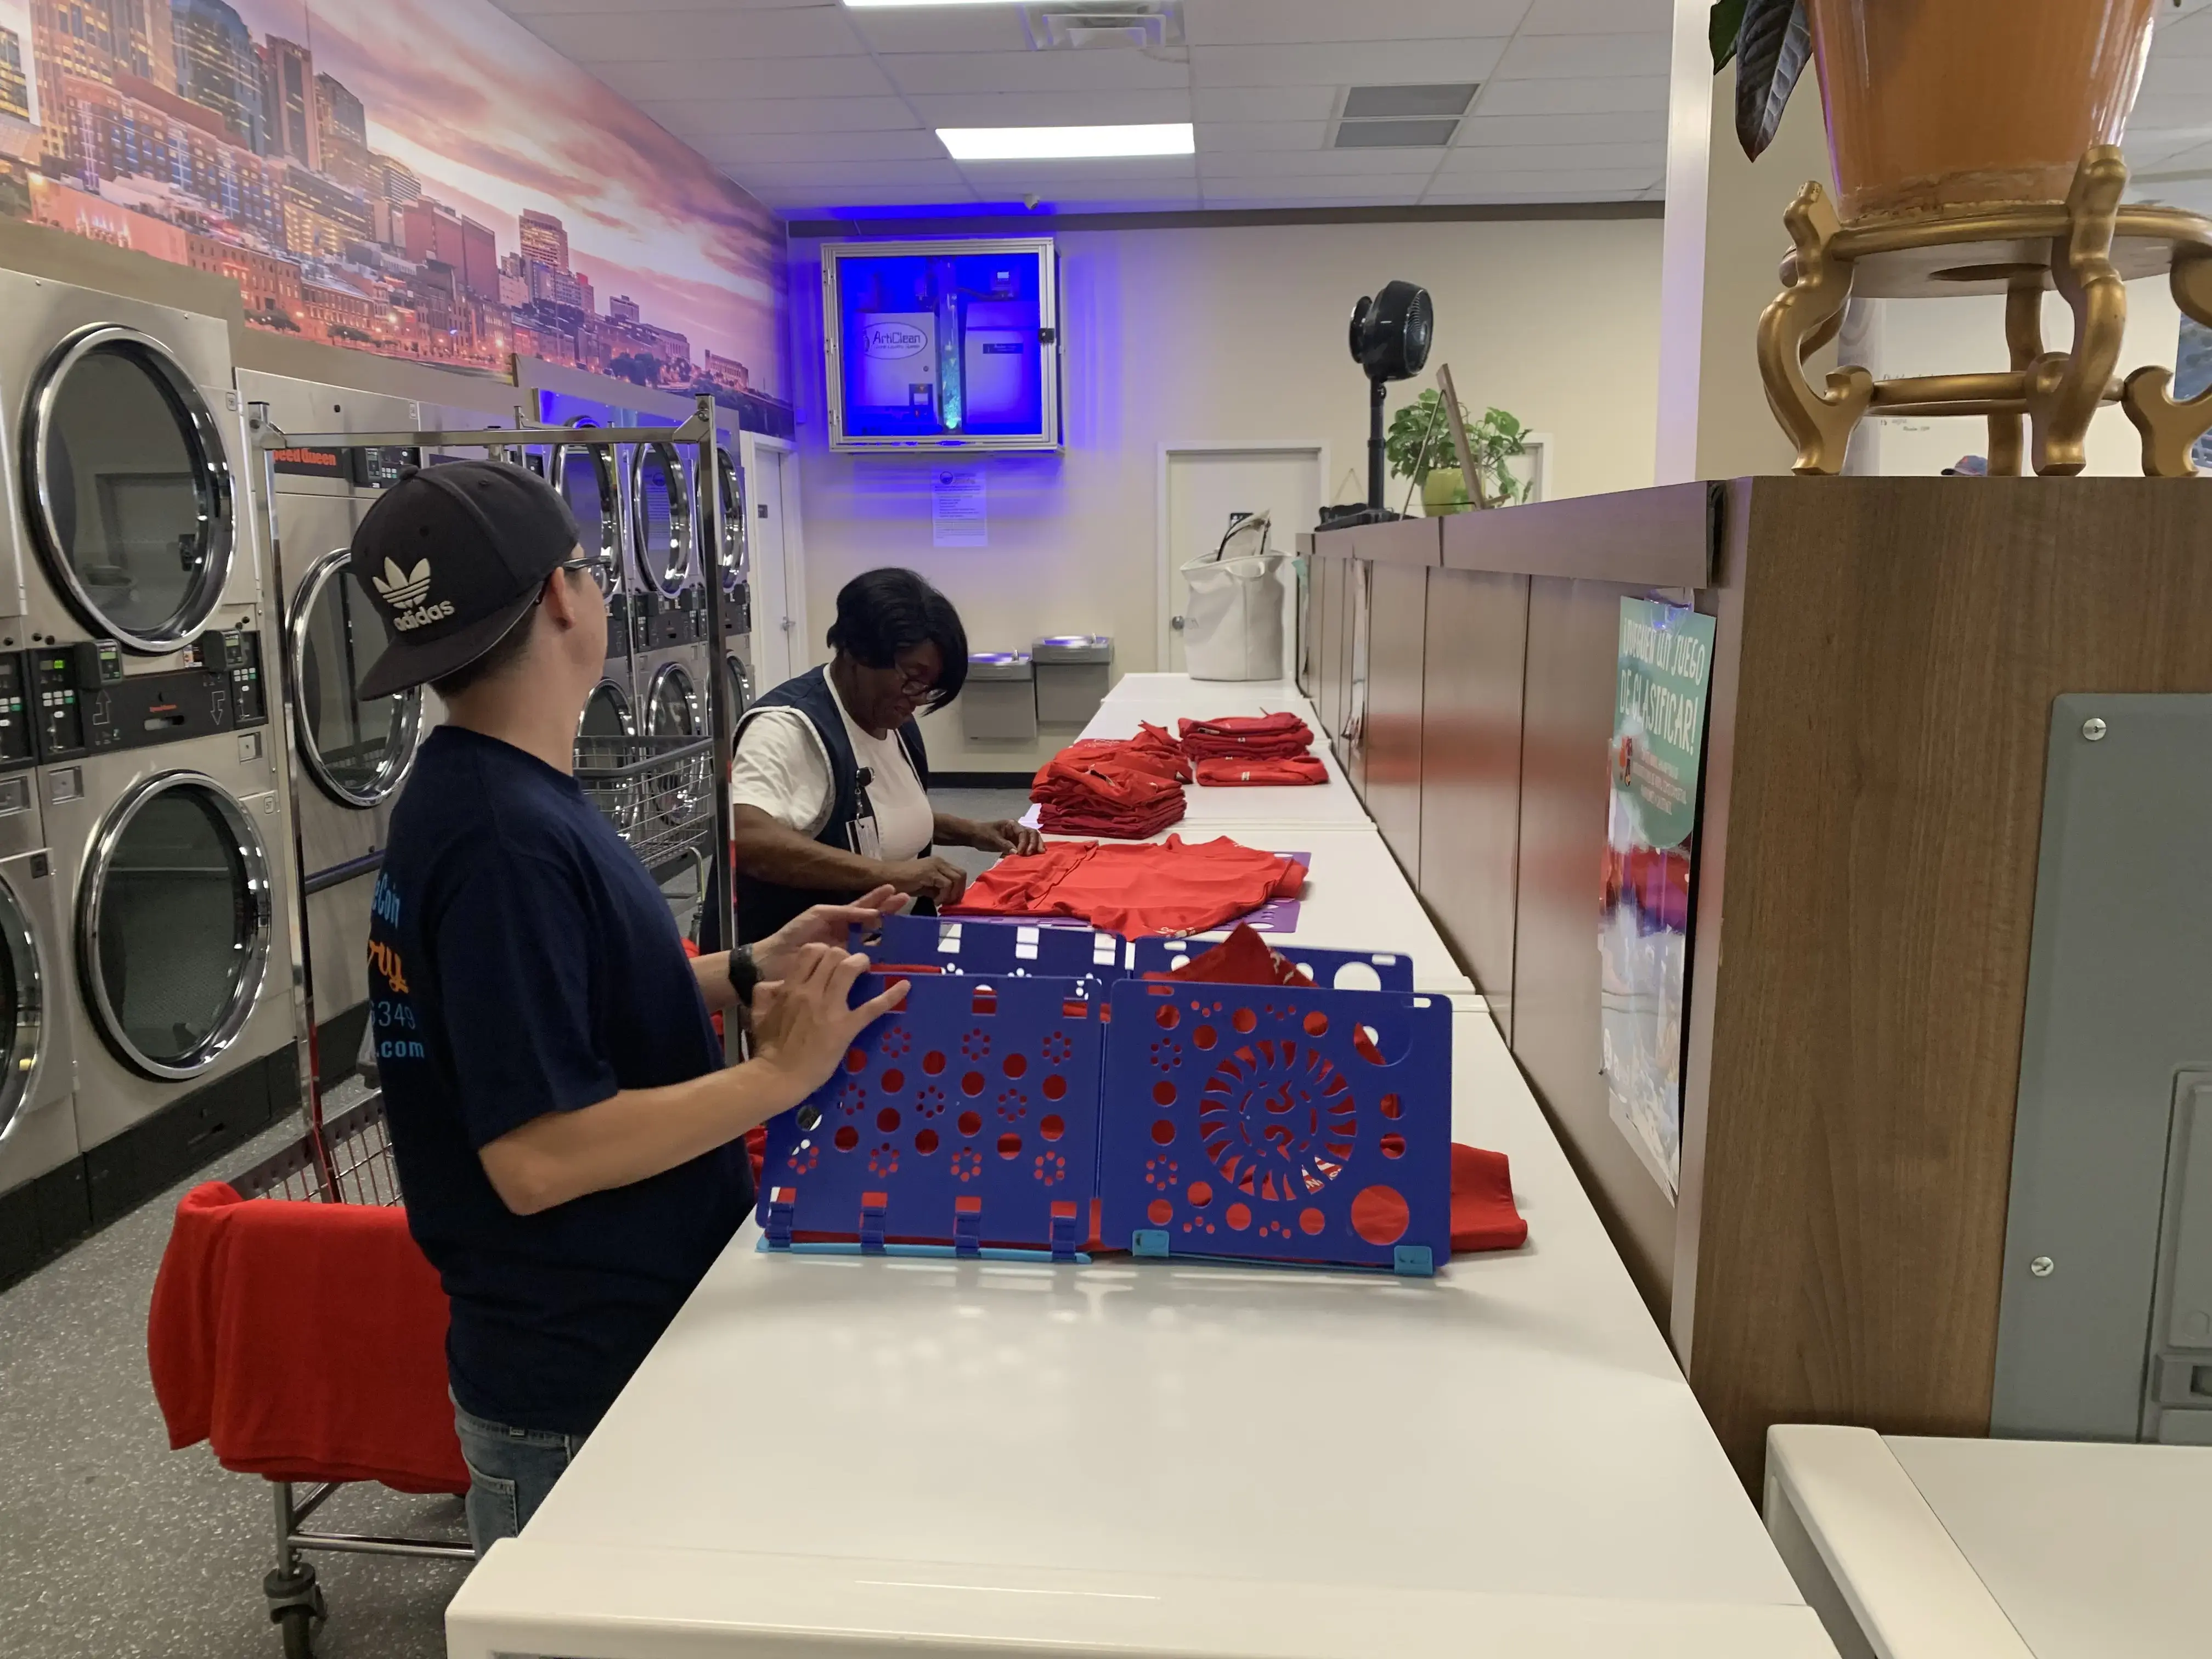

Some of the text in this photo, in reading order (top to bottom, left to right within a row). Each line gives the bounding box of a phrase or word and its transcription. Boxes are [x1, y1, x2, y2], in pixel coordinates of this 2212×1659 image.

[872, 331, 921, 345] ArtiClean
[393, 601, 455, 631] adidas
[1671, 635, 1705, 686] JUEGO
[1620, 669, 1699, 756] DE CLASIFICAR!
